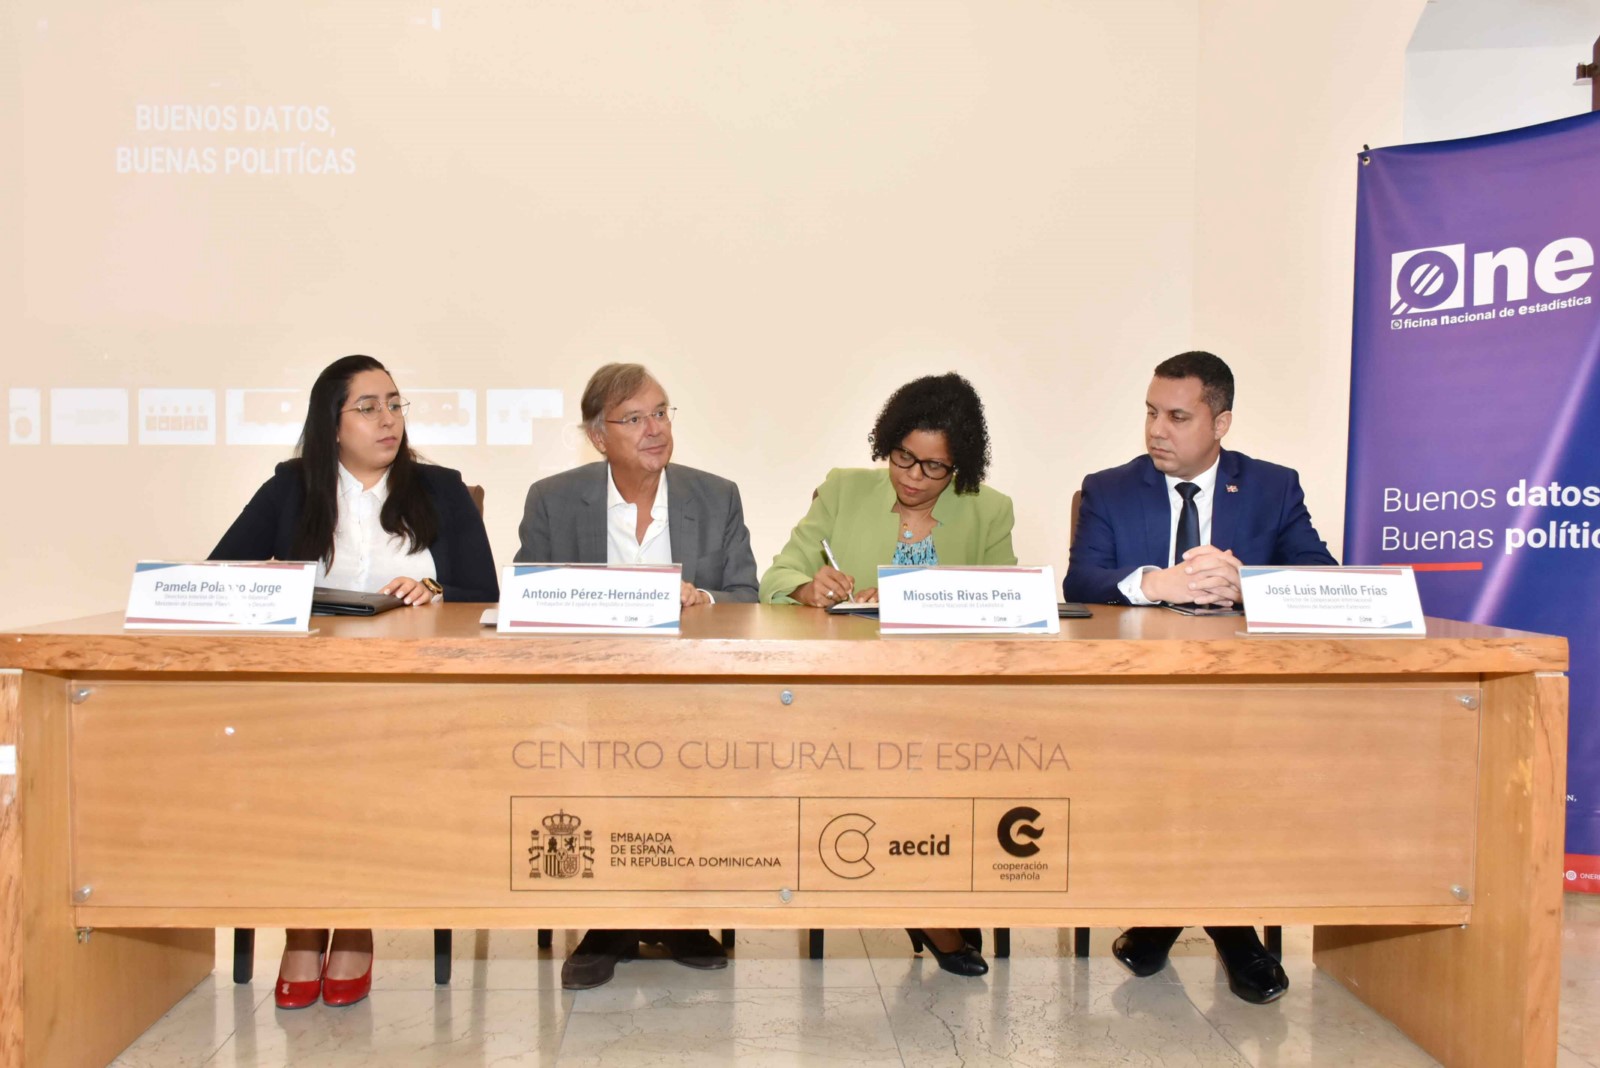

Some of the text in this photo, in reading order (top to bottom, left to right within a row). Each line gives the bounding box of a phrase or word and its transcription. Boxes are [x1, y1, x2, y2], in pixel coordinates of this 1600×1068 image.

[136, 104, 336, 137] BUENOS DATOS,
[116, 146, 217, 174] BUENAS
[1441, 309, 1496, 325] nacional
[1499, 307, 1515, 318] de
[1518, 295, 1592, 315] estadística
[1383, 479, 1600, 513] Buenos datos
[1382, 525, 1494, 551] Buenas
[154, 581, 197, 593] Pamela
[249, 582, 282, 596] Jorge
[522, 588, 670, 601] Antonio Pérez-Hernández
[903, 589, 1022, 601] Miosotis Rivas Peña
[1265, 584, 1388, 597] José Luis Morillo Frías
[511, 735, 1071, 772] CENTRO CULTURAL DE ESPAÑA
[610, 832, 672, 845] EMBAJADA
[888, 834, 951, 856] aecid
[610, 842, 676, 855] DE ESPAÑA
[610, 854, 782, 868] EN REPÚBLICA DOMINICANA
[992, 860, 1049, 872] cooperación
[999, 872, 1041, 882] española
